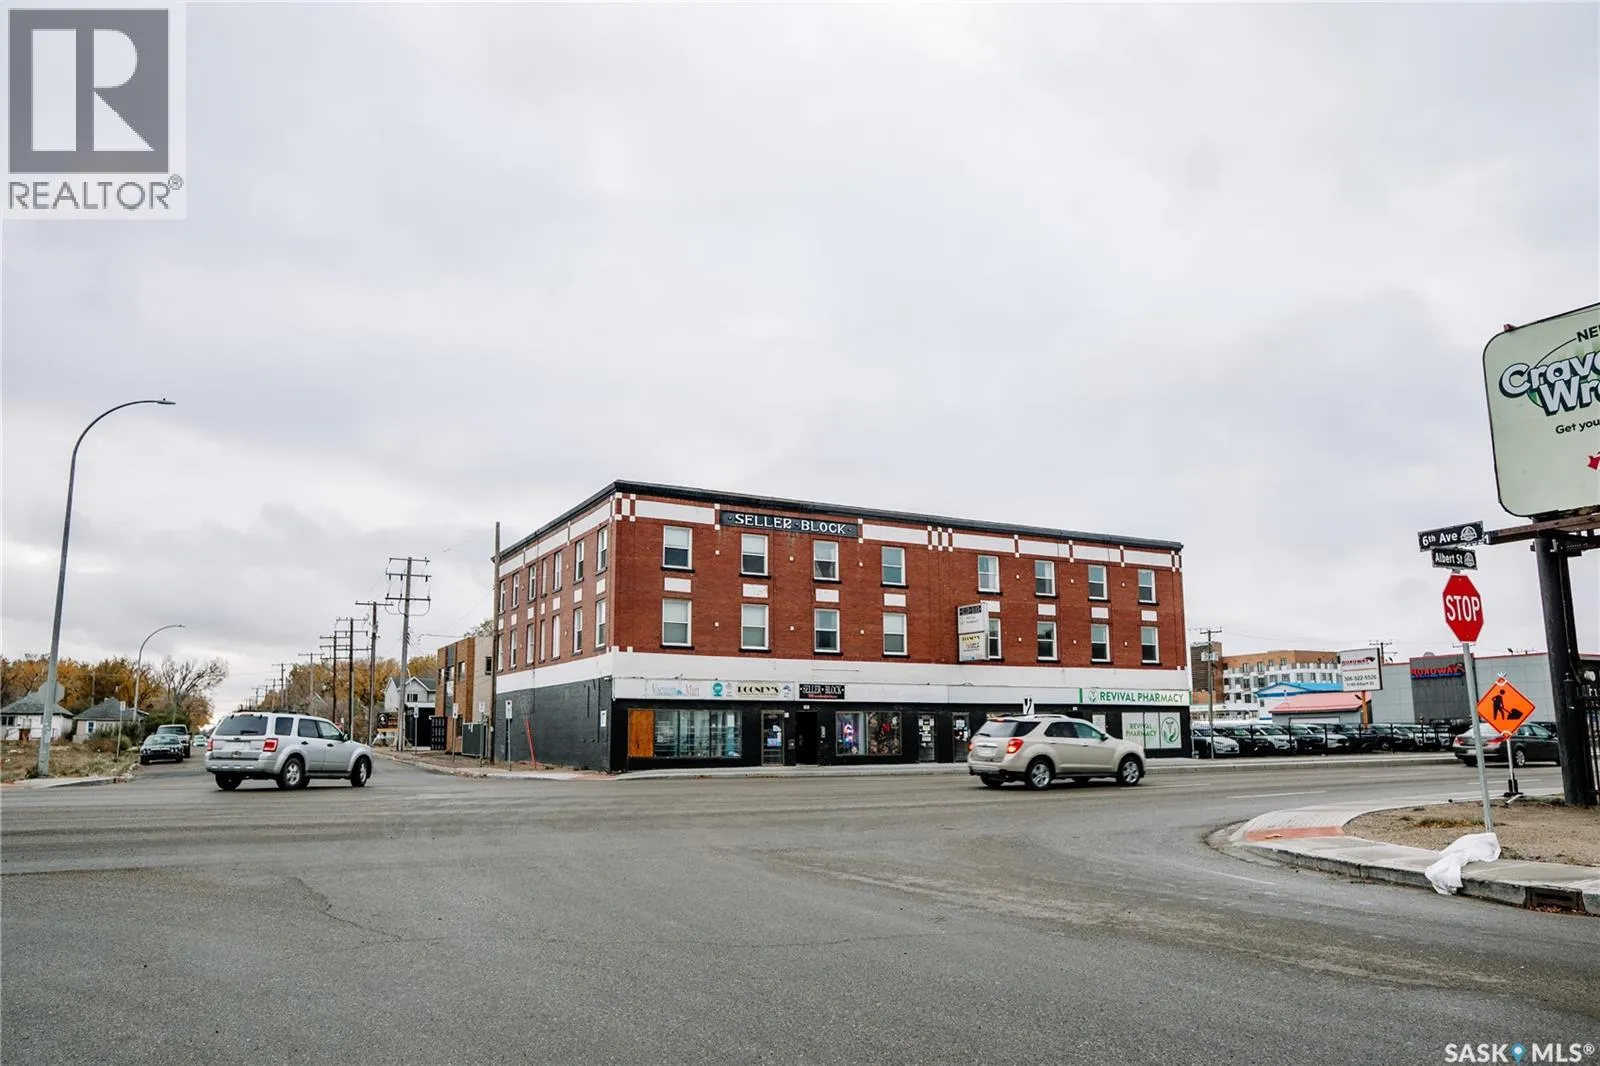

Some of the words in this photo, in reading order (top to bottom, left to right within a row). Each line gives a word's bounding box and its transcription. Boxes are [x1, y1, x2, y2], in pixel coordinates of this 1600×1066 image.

[1555, 423, 1577, 434] Get
[734, 513, 792, 530] SELLER
[801, 519, 847, 535] BLOCK
[1422, 534, 1437, 547] 6th
[1439, 532, 1458, 544] Ave
[1435, 552, 1456, 564] Albert
[1456, 553, 1464, 565] St
[1445, 594, 1480, 622] STOP
[1411, 664, 1458, 678] ROADWAY
[802, 684, 821, 694] SELLER
[824, 685, 842, 695] BLOCK
[1099, 691, 1136, 702] REVIVAL
[1137, 692, 1184, 703] PHARMACY
